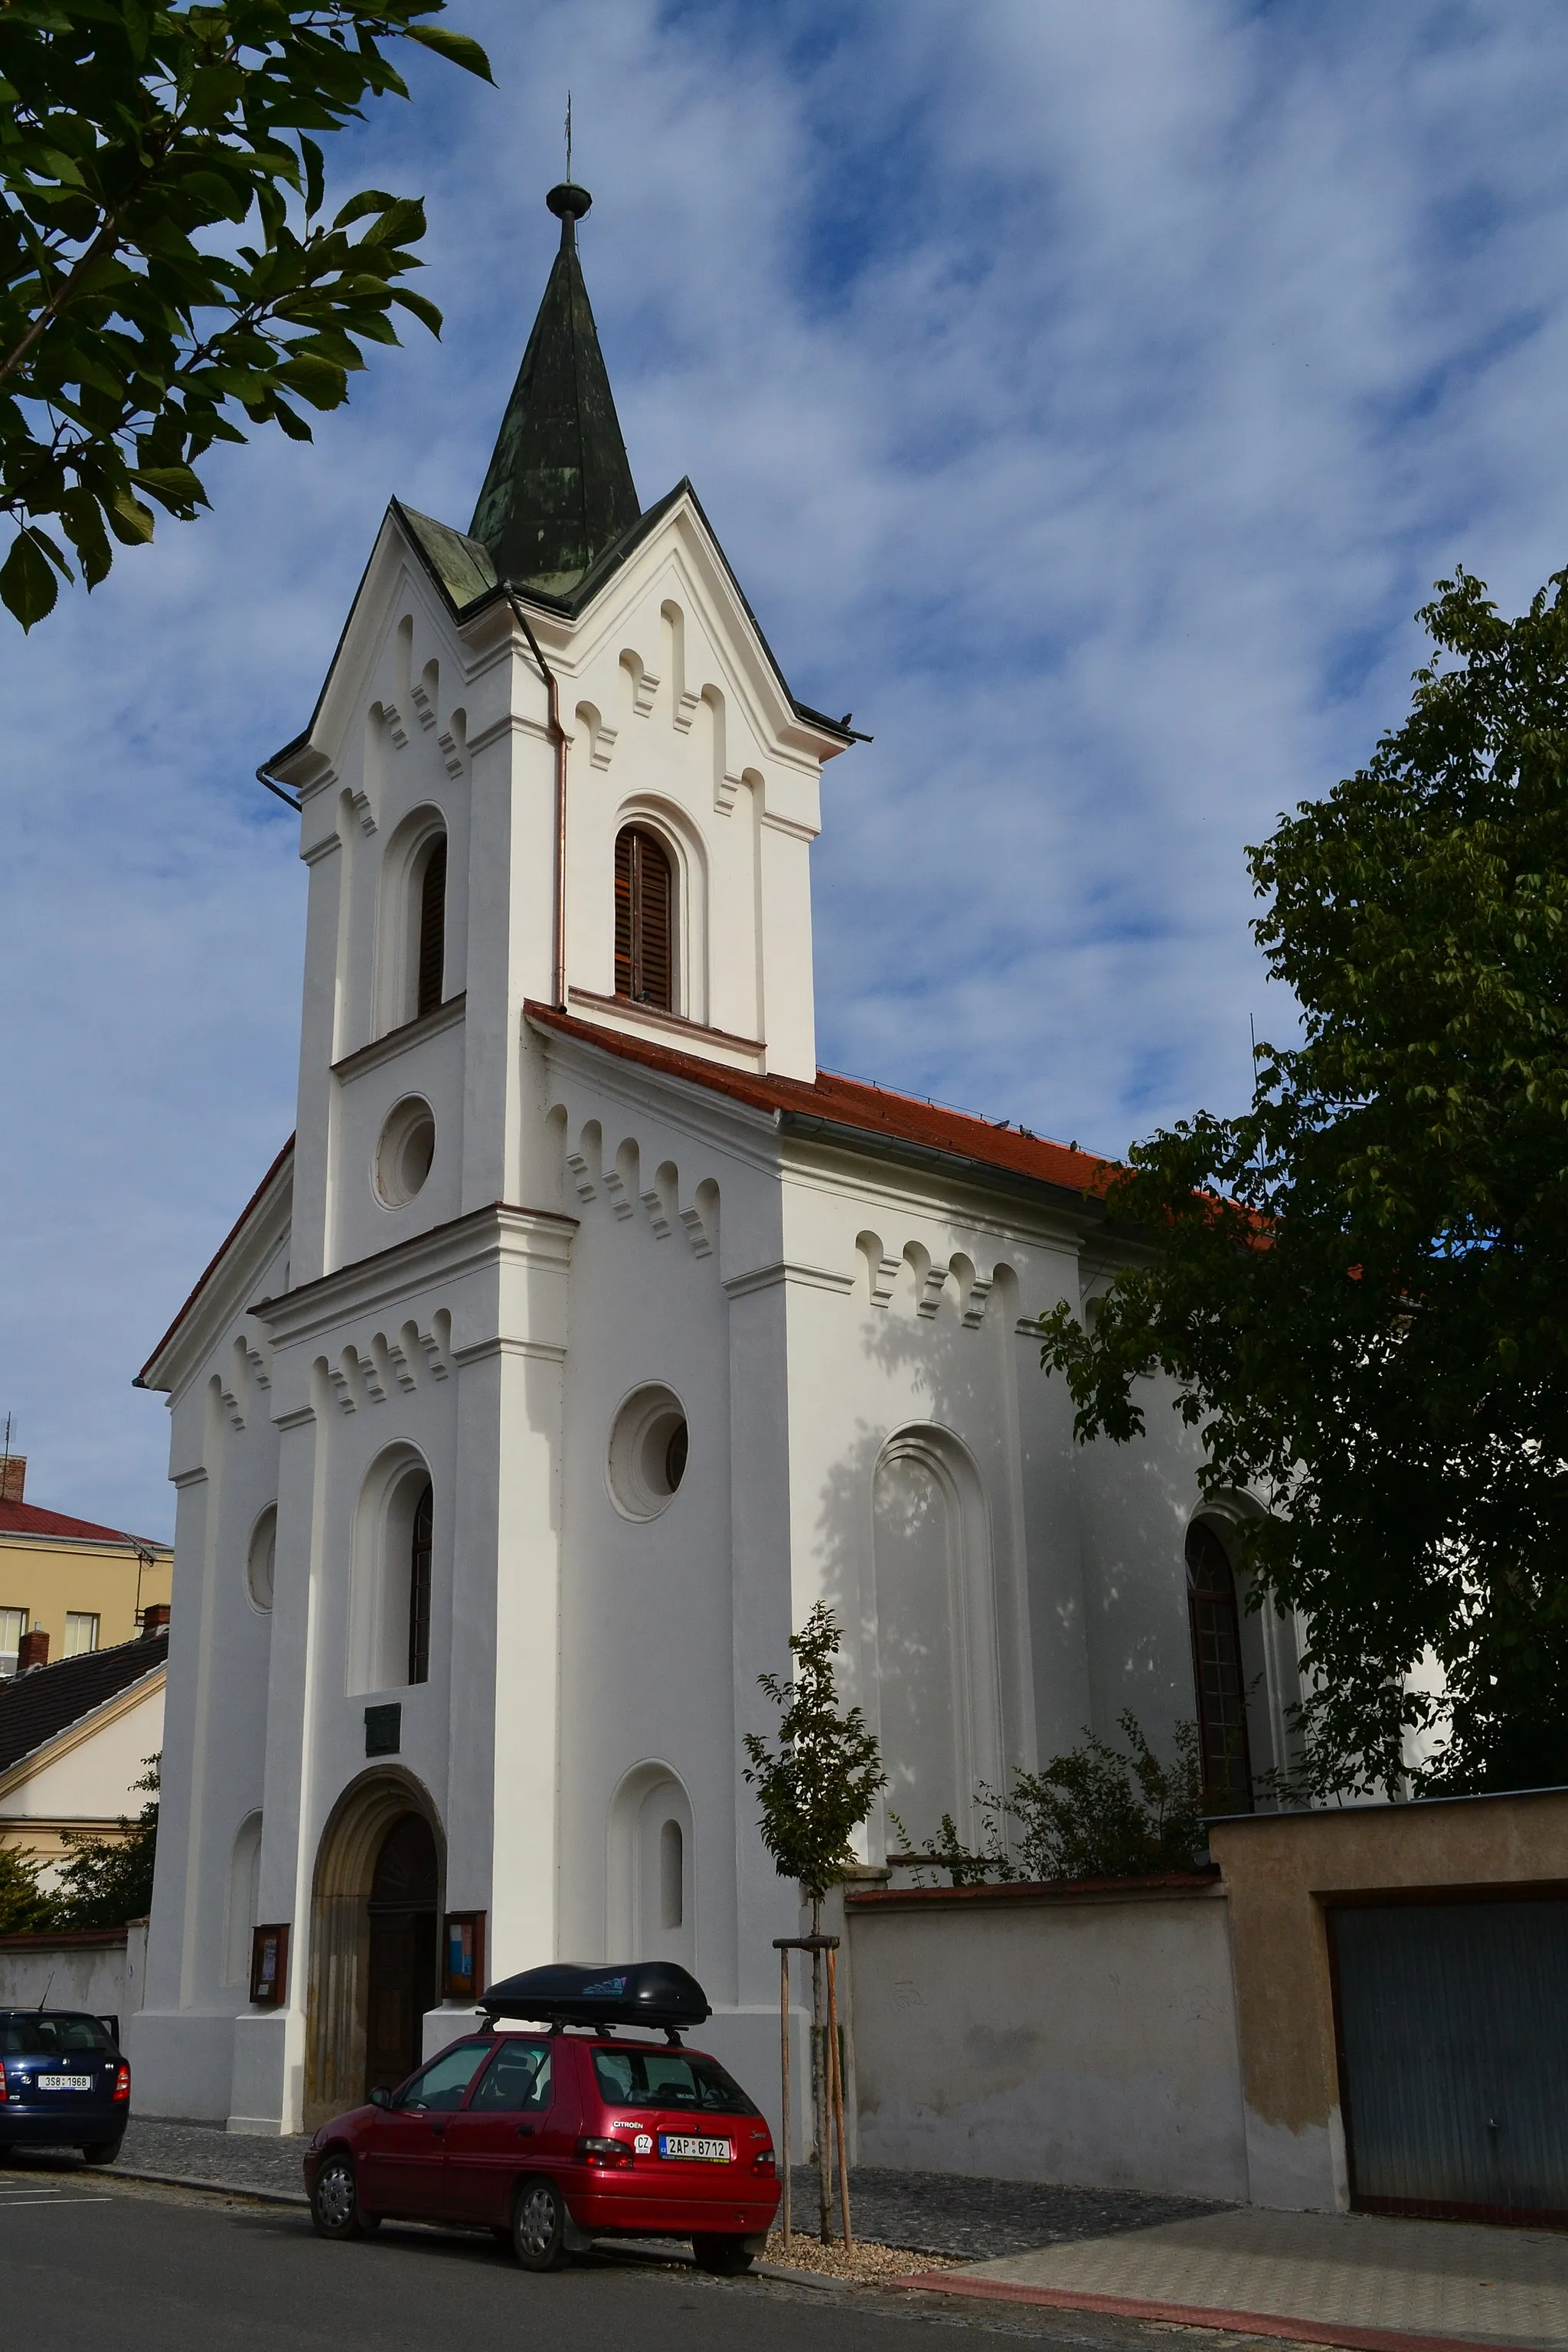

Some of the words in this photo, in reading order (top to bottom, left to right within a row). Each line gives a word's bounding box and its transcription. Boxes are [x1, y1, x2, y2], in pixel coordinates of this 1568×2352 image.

[46, 2077, 60, 2086] 3S8
[67, 2077, 87, 2086] 1968
[613, 2121, 643, 2129] CITROËN
[638, 2137, 649, 2148] CZ
[669, 2138, 689, 2154] 2AP
[698, 2141, 724, 2157] 8712
